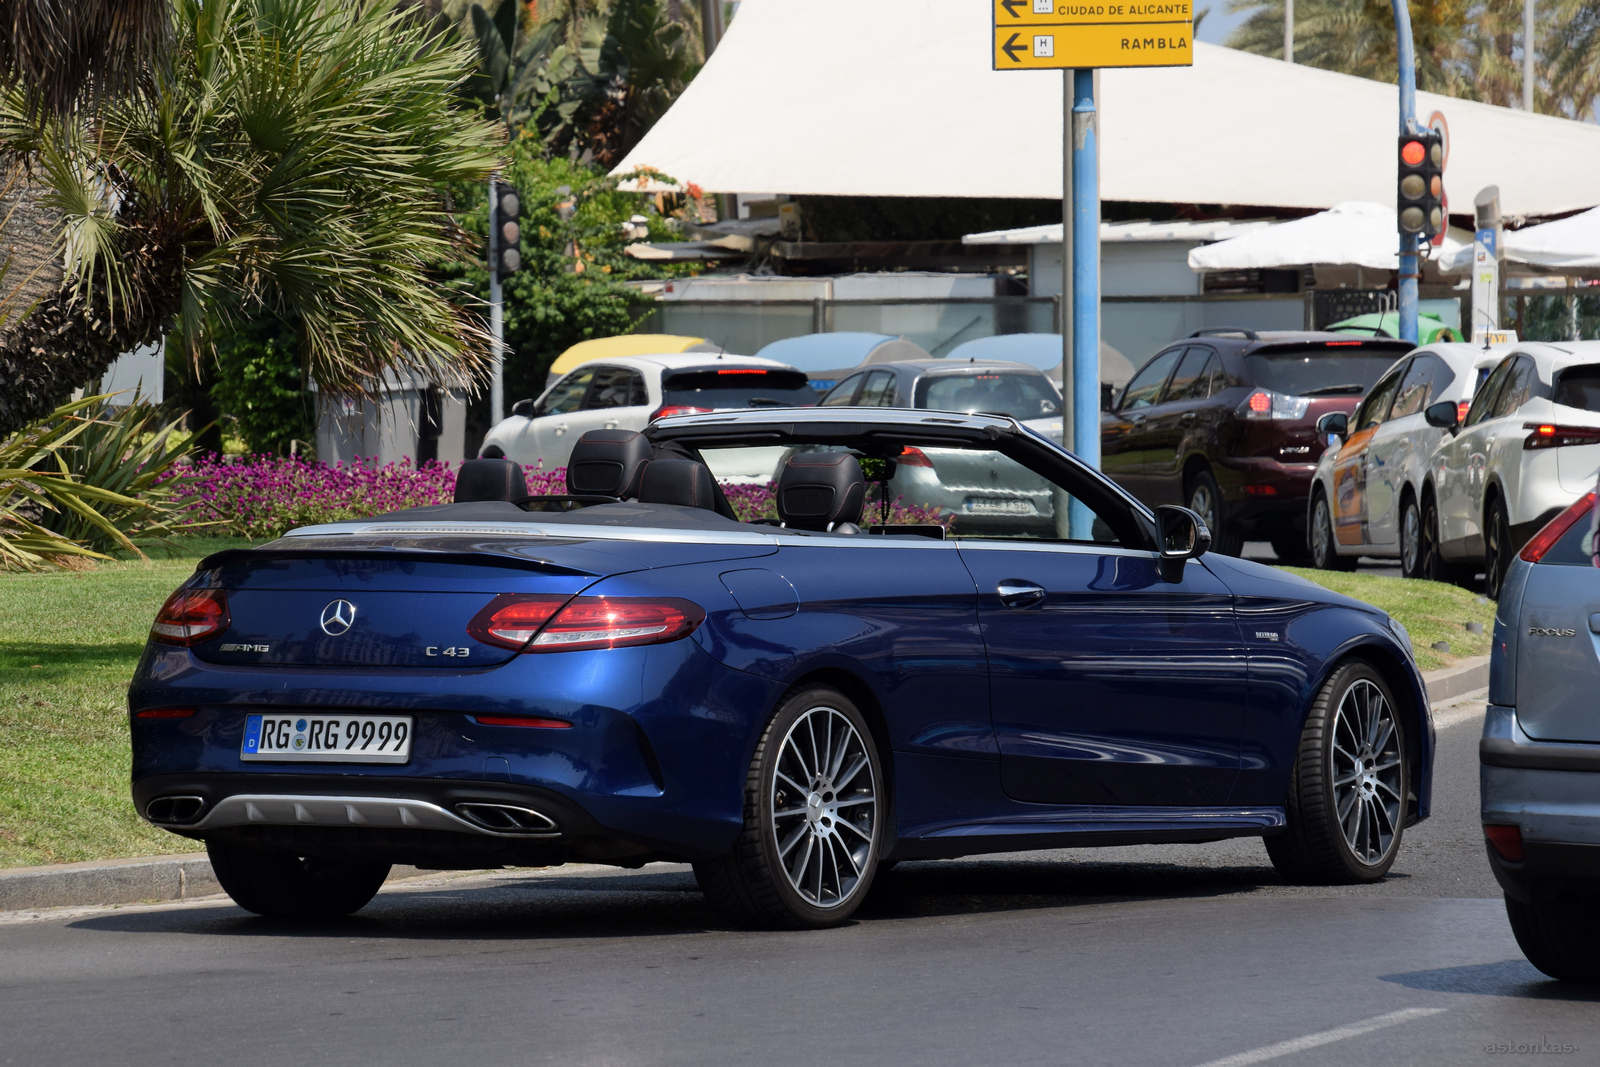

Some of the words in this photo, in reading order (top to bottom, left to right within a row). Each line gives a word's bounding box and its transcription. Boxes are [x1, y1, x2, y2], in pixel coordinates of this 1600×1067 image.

[1058, 6, 1104, 15] CIUDAD
[1108, 6, 1124, 15] DE
[1129, 4, 1189, 15] ALICANTE
[1040, 38, 1047, 47] H
[1121, 37, 1187, 50] RAMBLA
[1484, 333, 1507, 344] TAXI
[1528, 626, 1576, 637] FOCUS
[234, 643, 270, 653] AMG
[425, 646, 438, 657] C
[442, 646, 470, 658] 43
[260, 719, 291, 749] RG
[307, 720, 340, 750] RG
[345, 721, 408, 751] 9999
[248, 738, 255, 748] D
